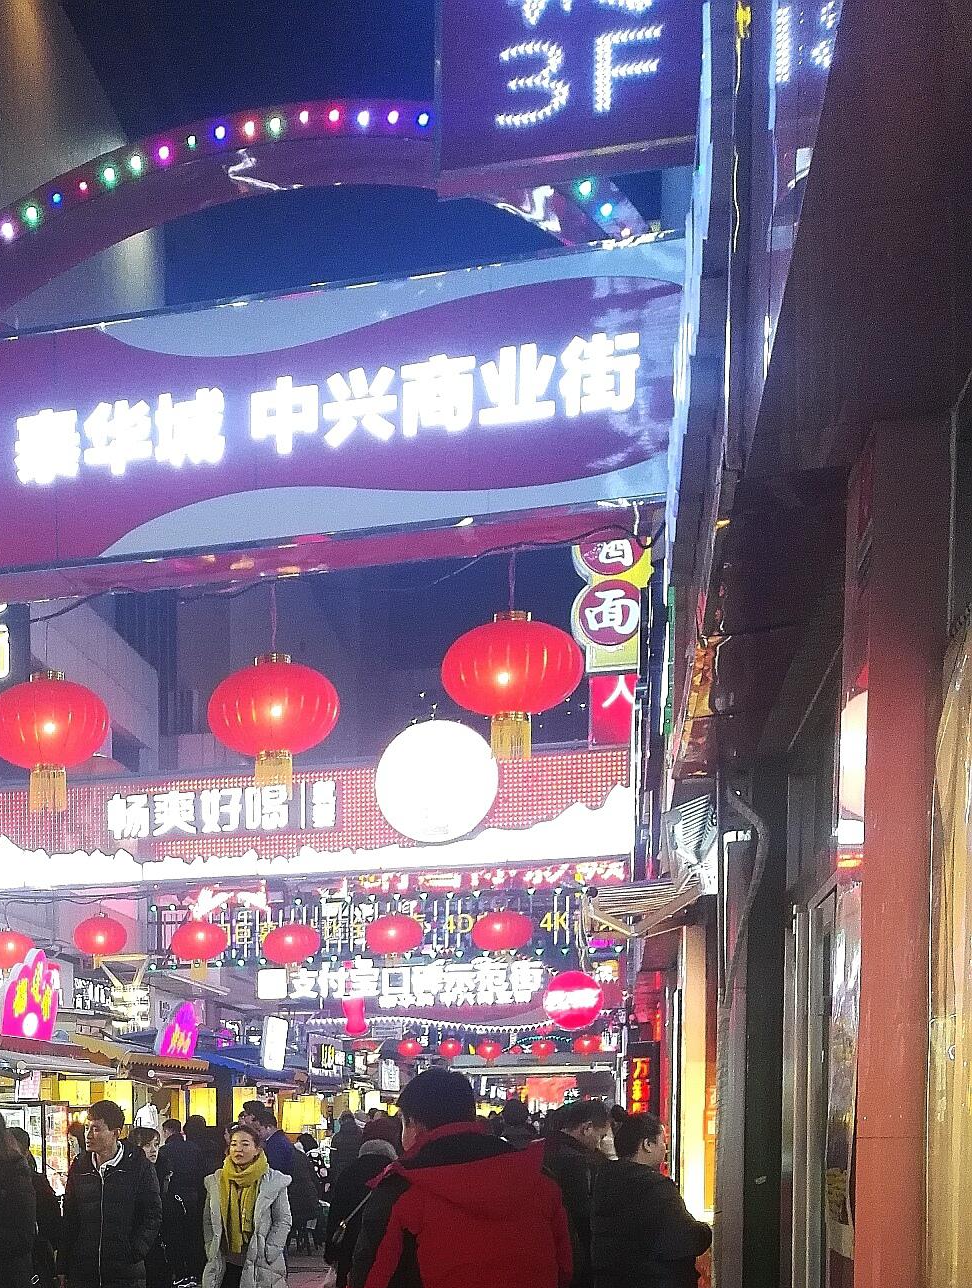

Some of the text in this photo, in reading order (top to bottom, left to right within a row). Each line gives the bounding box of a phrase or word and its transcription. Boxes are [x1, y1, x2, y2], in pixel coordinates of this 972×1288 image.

[496, 24, 665, 128] 3F
[249, 331, 641, 456] 中兴商业街
[107, 784, 290, 841] 畅爽好喝
